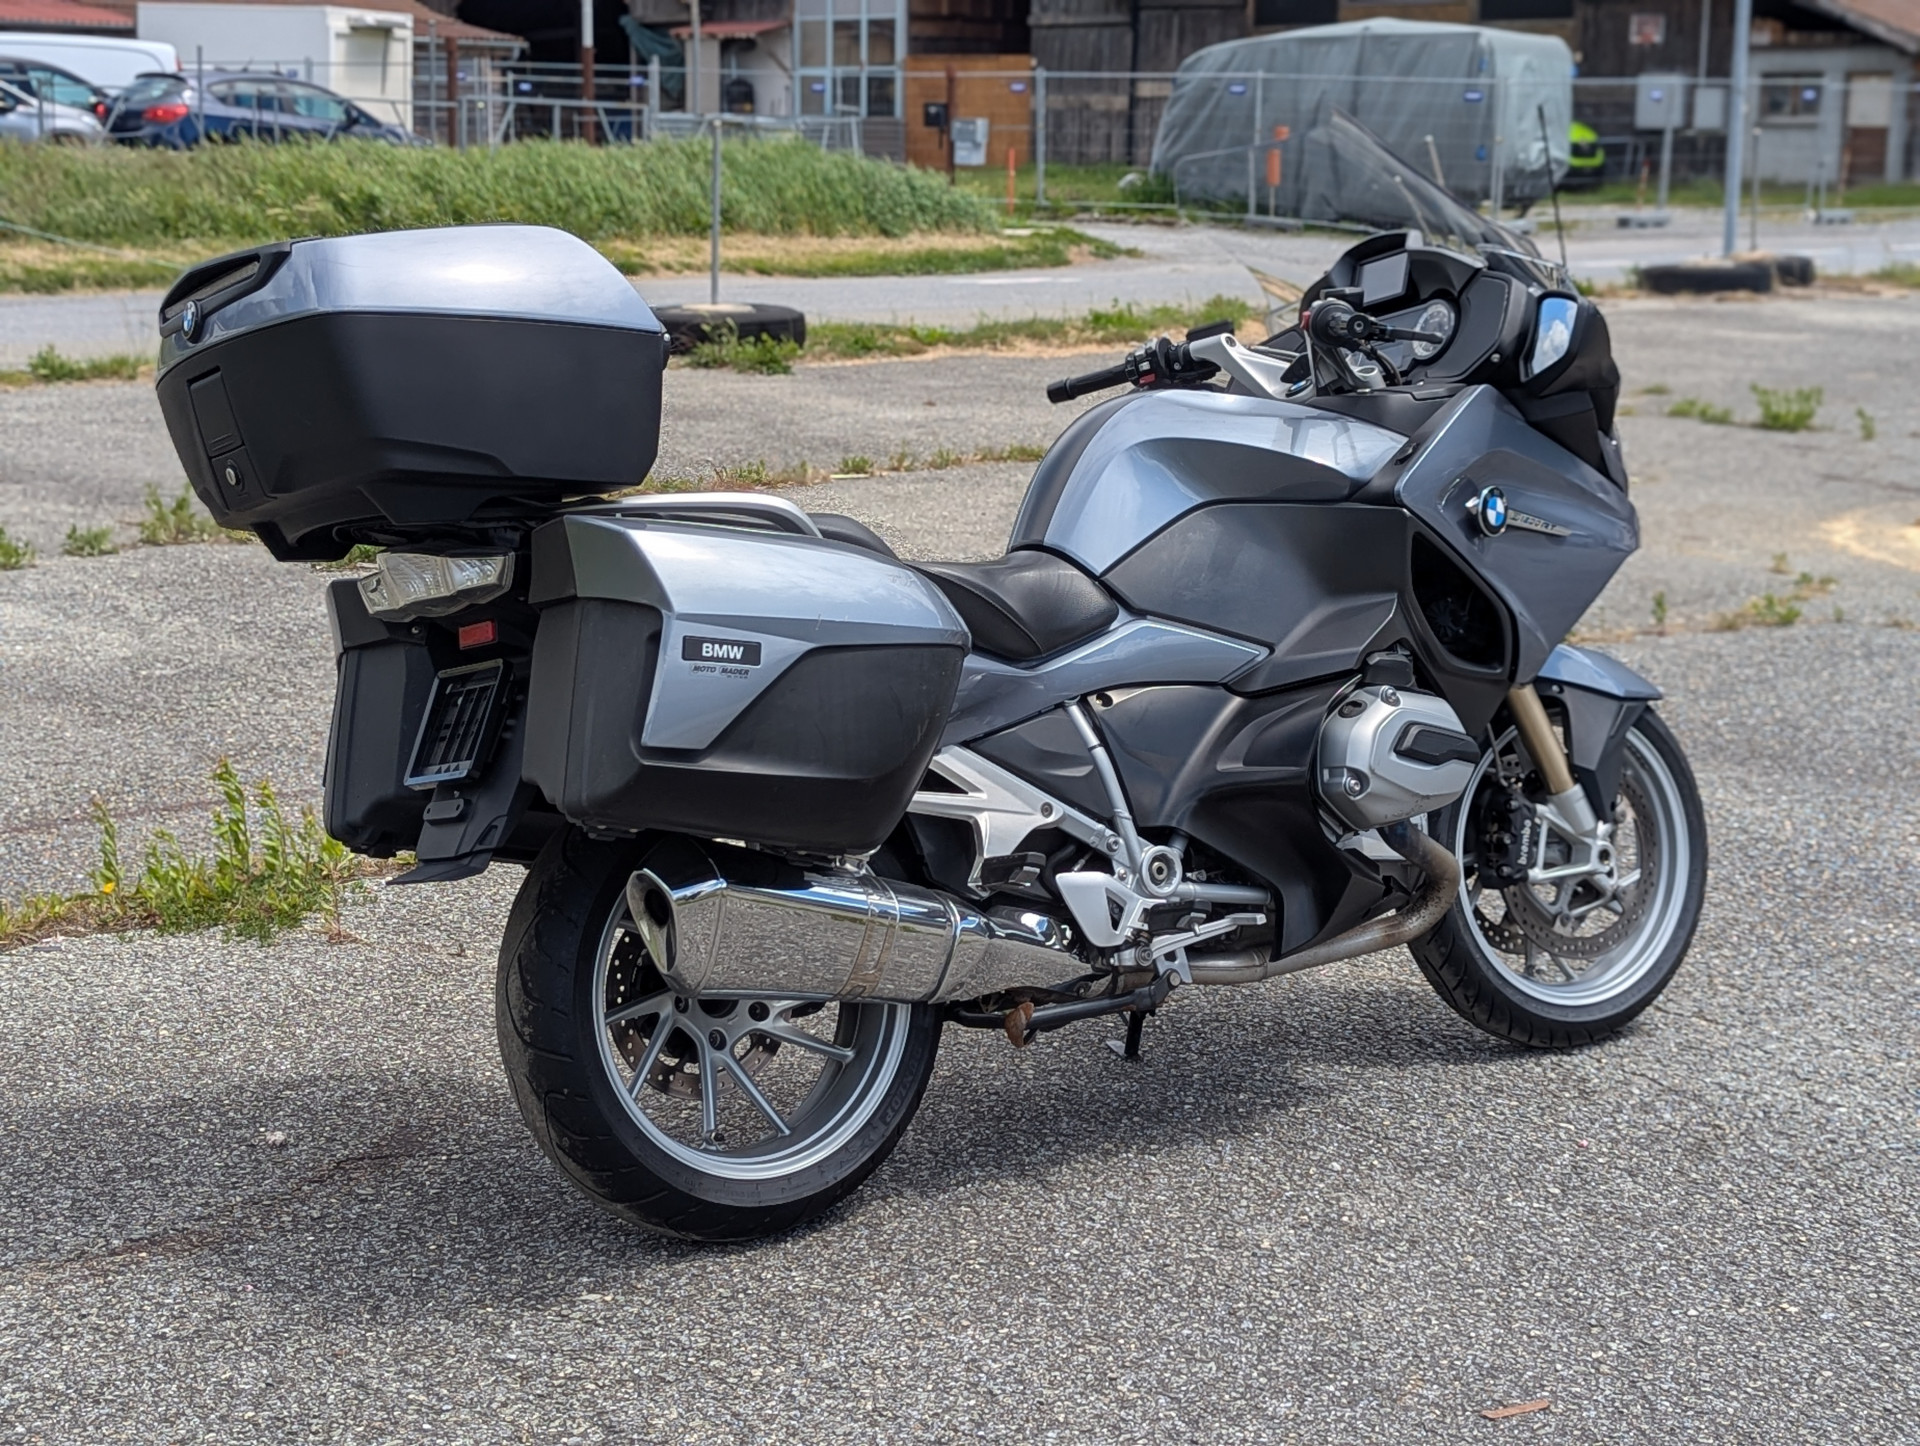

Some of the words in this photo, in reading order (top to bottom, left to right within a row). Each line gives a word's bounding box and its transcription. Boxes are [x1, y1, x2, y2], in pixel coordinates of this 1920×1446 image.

[702, 643, 744, 660] BMW
[692, 665, 717, 674] MOTO
[720, 667, 750, 676] MADER
[1517, 819, 1532, 865] brembo
[885, 1047, 922, 1123] DUNLOP
